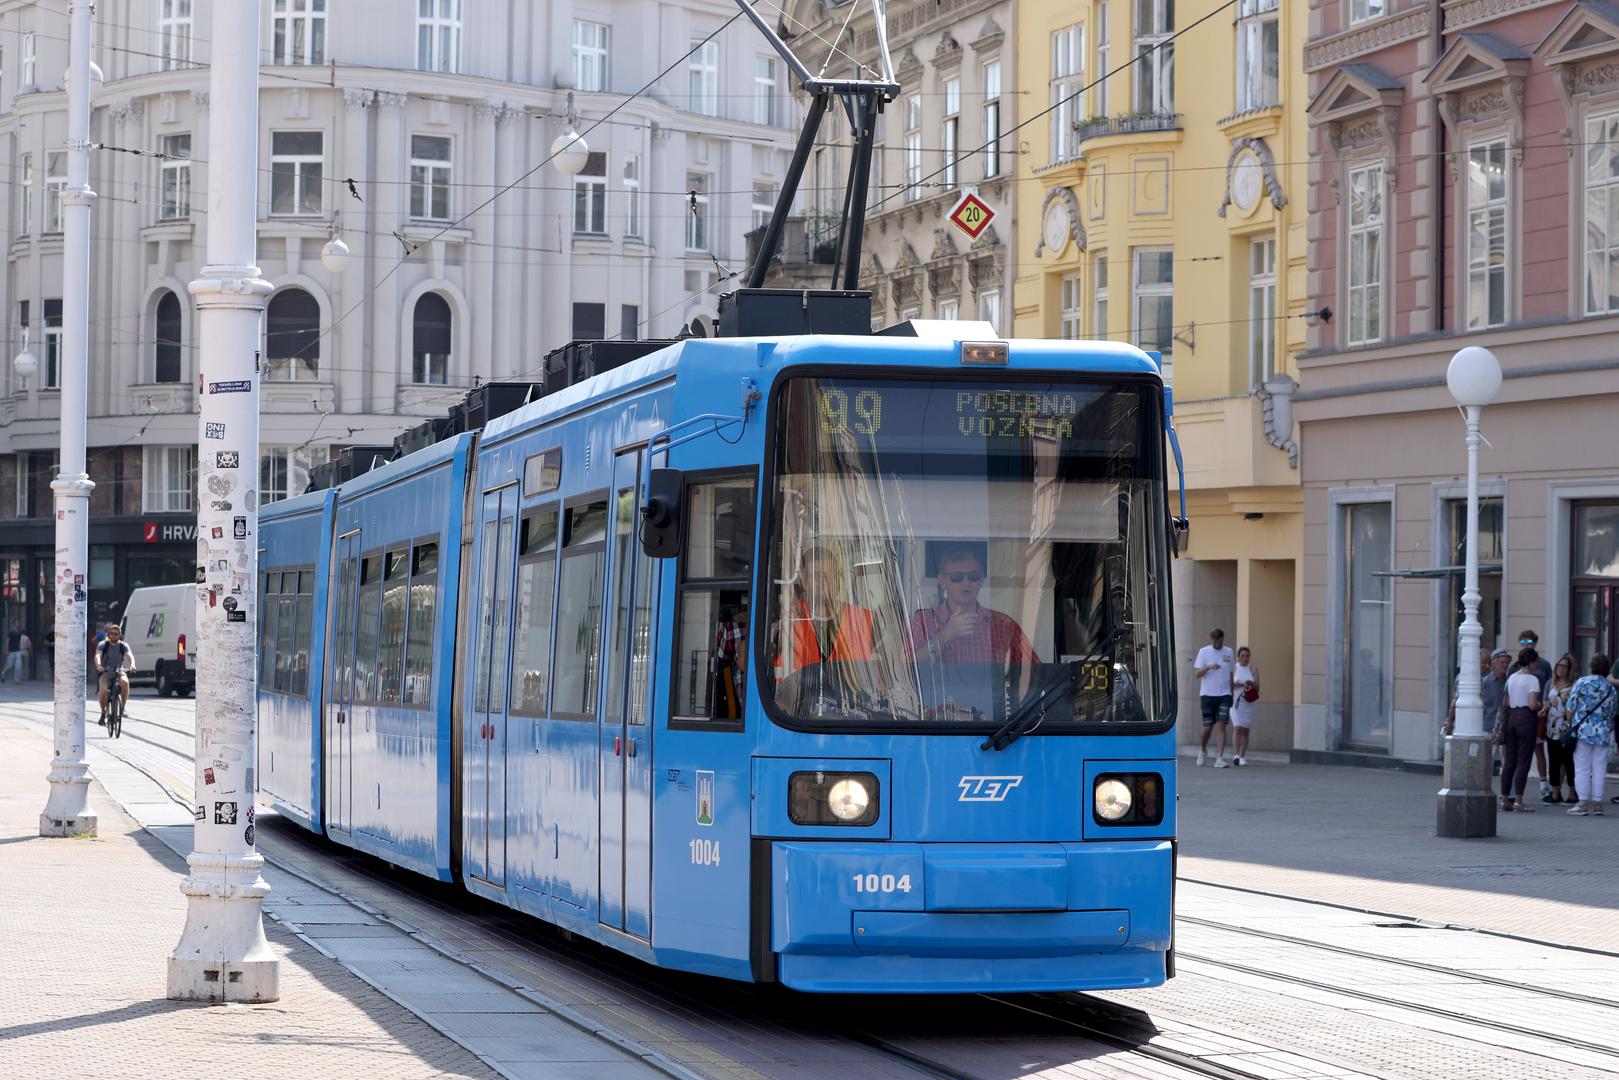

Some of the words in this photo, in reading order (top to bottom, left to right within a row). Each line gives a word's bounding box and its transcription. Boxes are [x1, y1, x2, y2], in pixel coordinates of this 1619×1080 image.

[966, 207, 979, 222] 20
[822, 390, 882, 433] 99
[957, 392, 1076, 414] POSEBNA
[958, 775, 1024, 802] ZET
[689, 839, 720, 866] 1004
[852, 873, 912, 893] 1004
